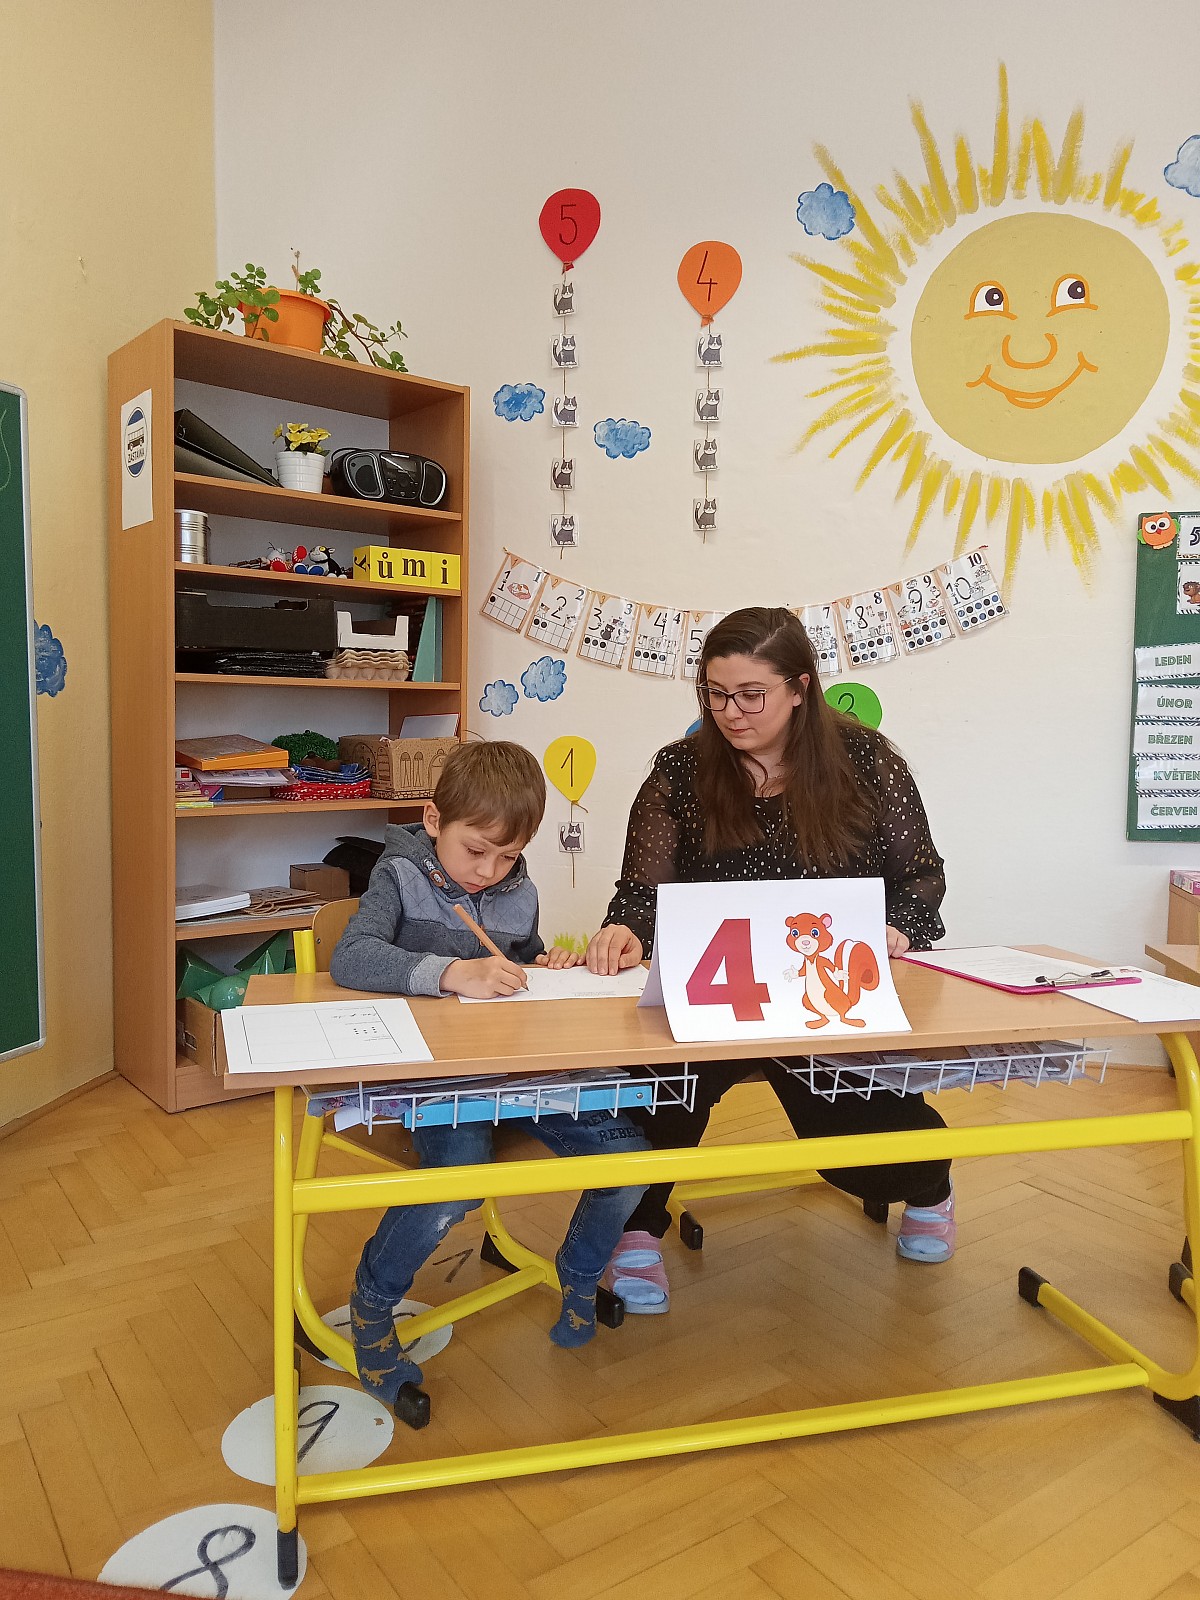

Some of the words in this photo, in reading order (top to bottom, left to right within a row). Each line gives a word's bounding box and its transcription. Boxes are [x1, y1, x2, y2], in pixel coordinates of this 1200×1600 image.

[559, 203, 578, 245] 5
[696, 250, 718, 302] 4
[967, 552, 983, 569] 10
[497, 570, 511, 592] 1
[532, 571, 542, 584] 1
[922, 575, 932, 588] 9
[574, 588, 585, 601] 2
[873, 591, 883, 605] 8
[908, 588, 923, 613] 9
[945, 577, 973, 606] 10
[550, 596, 567, 619] 2
[623, 603, 633, 615] 3
[822, 606, 831, 619] 7
[854, 605, 869, 629] 8
[588, 607, 602, 631] 3
[653, 612, 668, 635] 4
[672, 612, 681, 625] 4
[689, 629, 704, 653] 5
[1154, 654, 1192, 667] LEDEN
[1156, 695, 1193, 709] ÚNOR
[1147, 731, 1193, 745] BŘEZEN
[560, 747, 574, 788] 1
[1150, 803, 1198, 817] ČERVEN
[686, 918, 771, 1022] 4
